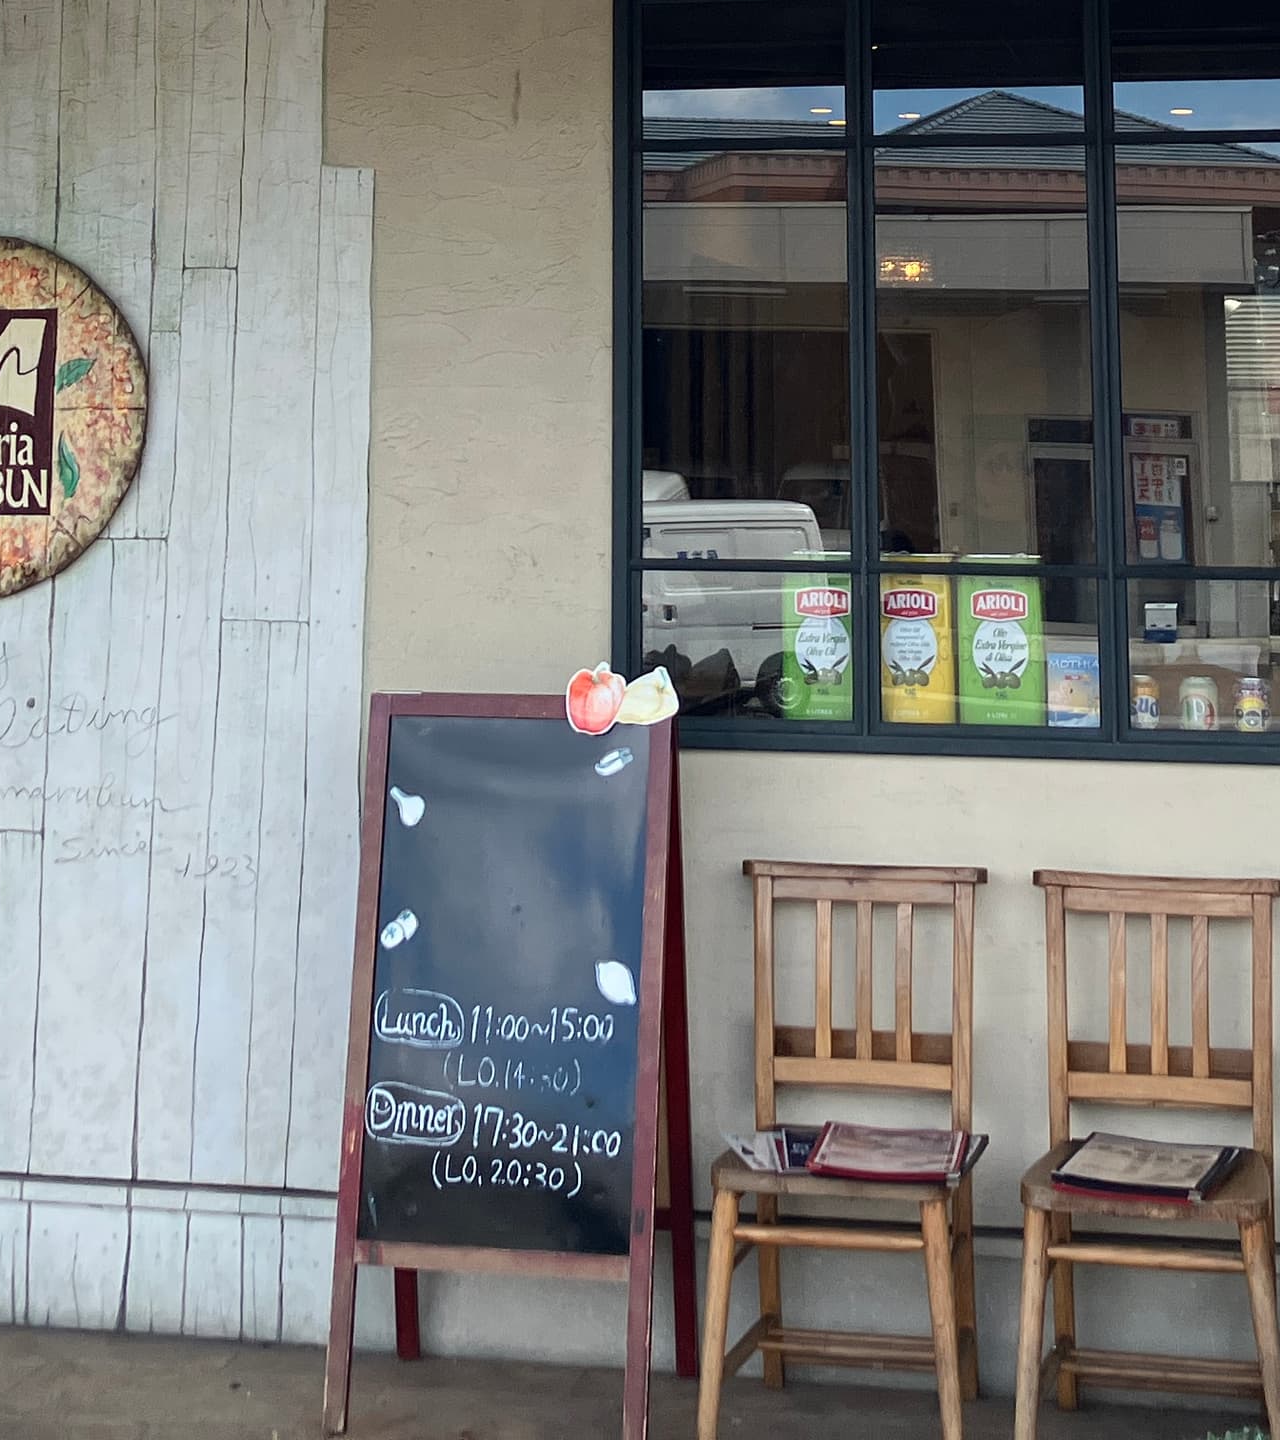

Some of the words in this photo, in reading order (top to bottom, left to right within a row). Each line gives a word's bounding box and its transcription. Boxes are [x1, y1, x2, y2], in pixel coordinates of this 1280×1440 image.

[800, 591, 847, 609] ARIOLI
[886, 593, 934, 613] ARIOLI
[976, 594, 1024, 612] ARIOLI
[379, 997, 458, 1041] Lunch
[370, 1087, 459, 1135] Dinner
